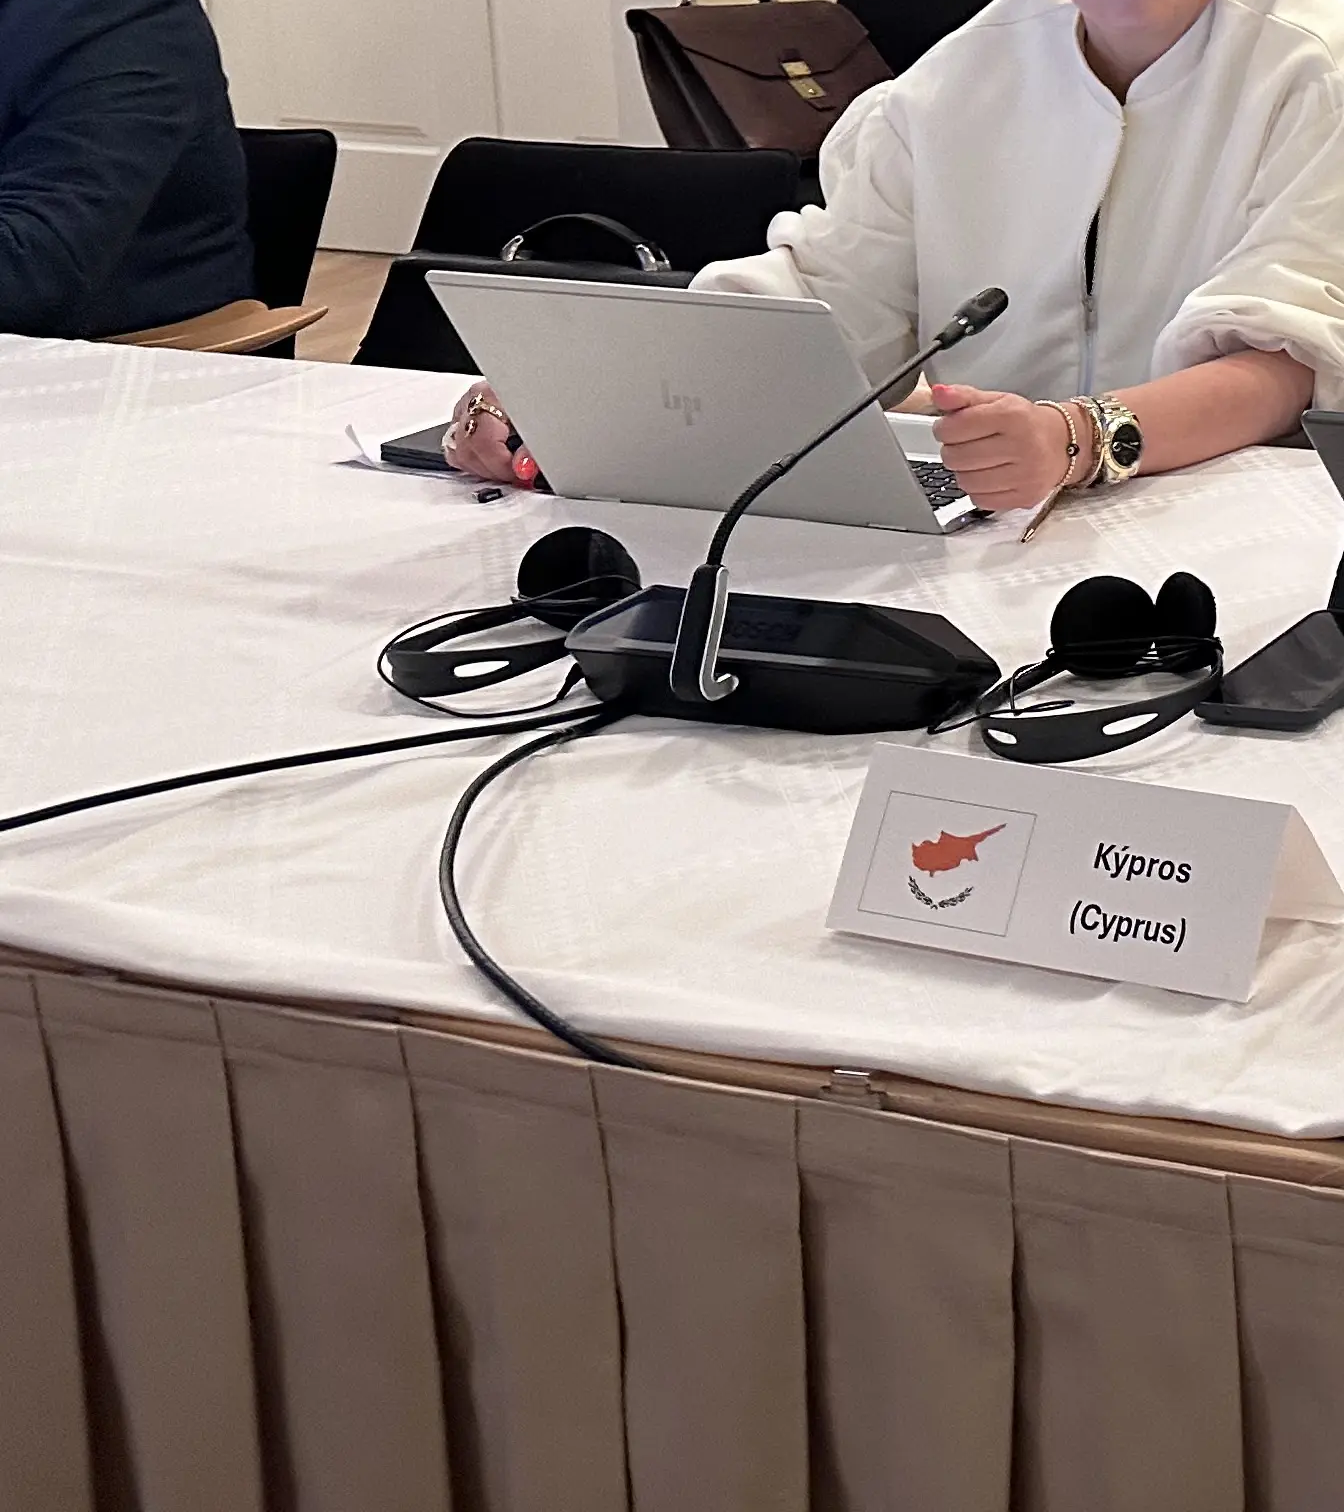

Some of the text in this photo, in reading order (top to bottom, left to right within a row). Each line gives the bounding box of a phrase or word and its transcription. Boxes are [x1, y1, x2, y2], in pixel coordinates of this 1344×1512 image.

[729, 619, 804, 643] OSCH
[1093, 842, 1192, 884] Kýpros
[1069, 900, 1187, 953] (Cyprus)
